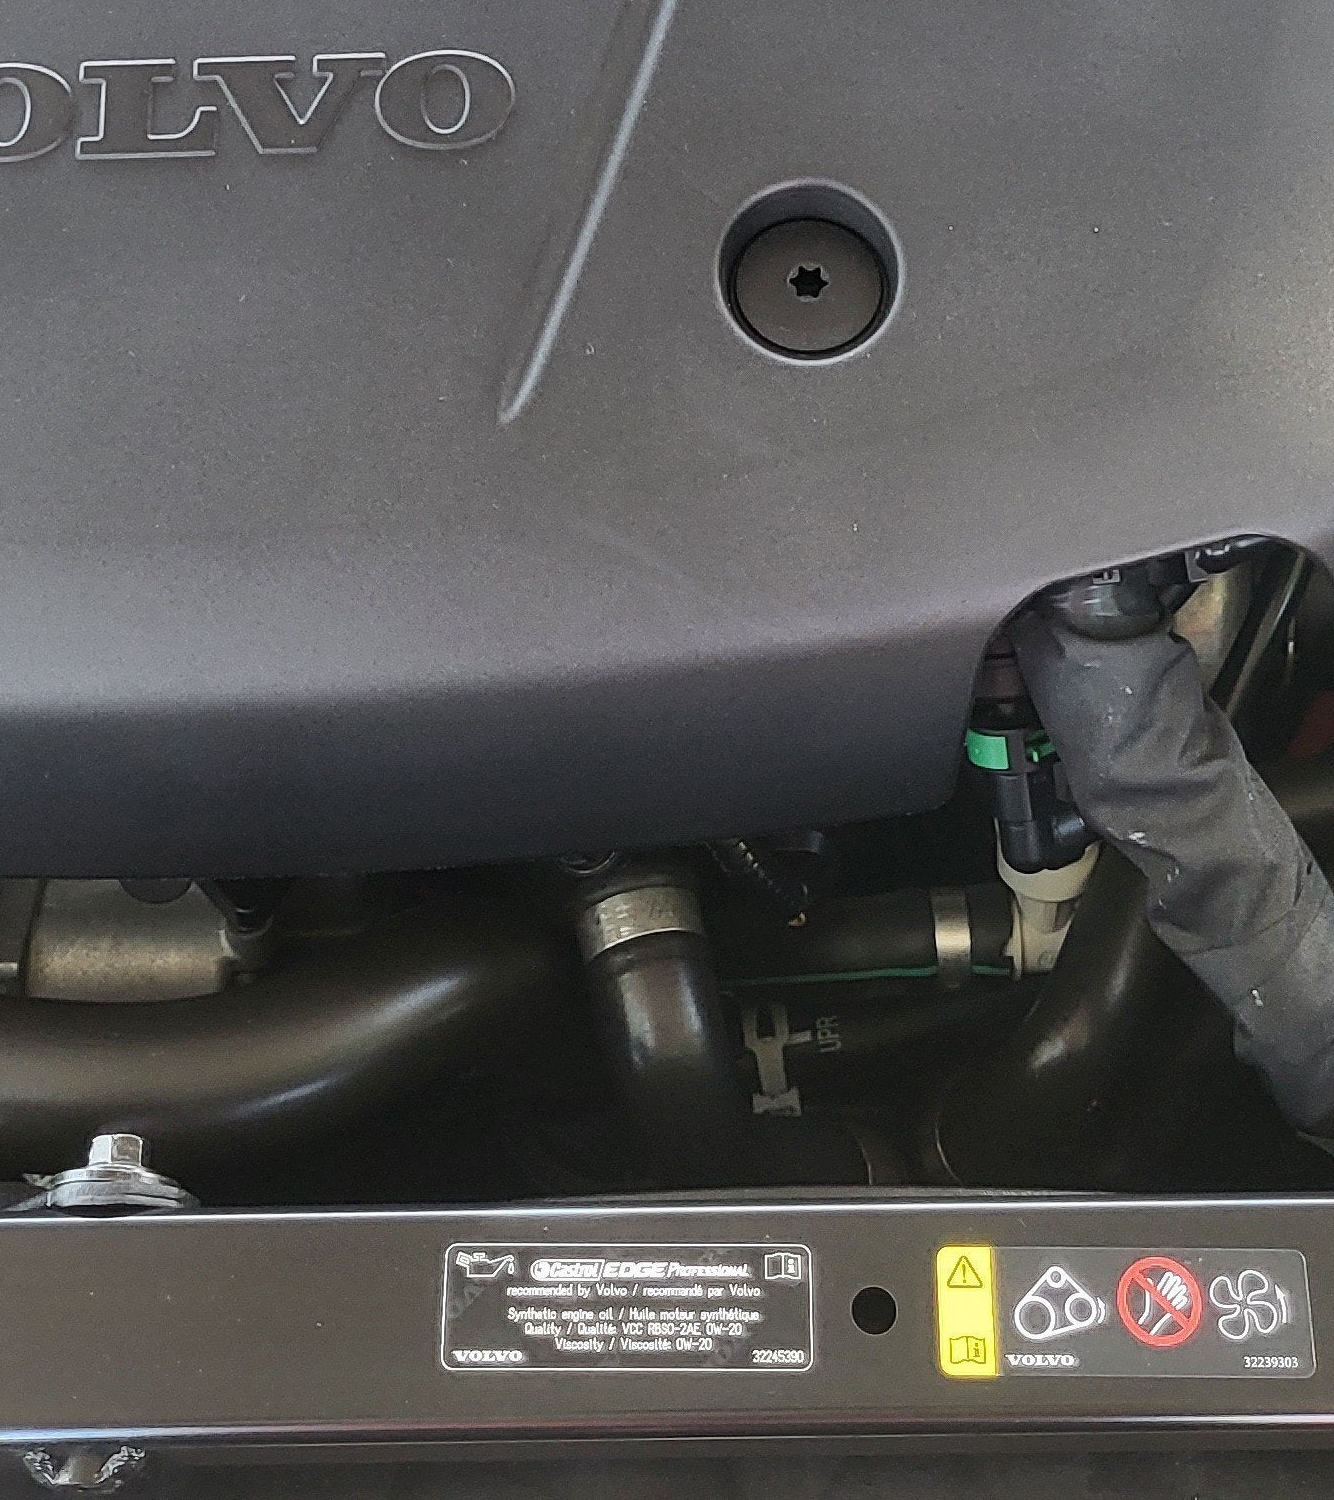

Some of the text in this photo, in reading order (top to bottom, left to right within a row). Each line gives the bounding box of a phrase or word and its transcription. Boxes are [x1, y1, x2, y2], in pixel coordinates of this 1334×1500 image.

[815, 1014, 842, 1053] UPR
[602, 1261, 669, 1279] EDGE
[506, 1283, 573, 1297] recommended
[577, 1284, 592, 1298] by
[595, 1283, 628, 1297] Volvo
[642, 1283, 704, 1297] recommandé
[707, 1286, 725, 1298] par
[728, 1283, 761, 1297] Volvo
[507, 1307, 557, 1323] Synthetic
[561, 1308, 594, 1323] engine
[598, 1307, 614, 1320] oil
[629, 1307, 656, 1320] Huile
[659, 1308, 696, 1320] moteur
[700, 1306, 761, 1323] synthétique
[524, 1322, 562, 1337] Quality
[621, 1322, 644, 1335] VCC
[705, 1322, 743, 1336] 0W-20
[554, 1337, 605, 1352] Viscosity
[675, 1337, 713, 1350] 0W-20
[451, 1350, 523, 1362] VOLVO
[751, 1350, 805, 1363] 32245390
[1004, 1353, 1075, 1367] VOLVO
[1243, 1356, 1299, 1369] 32239303
